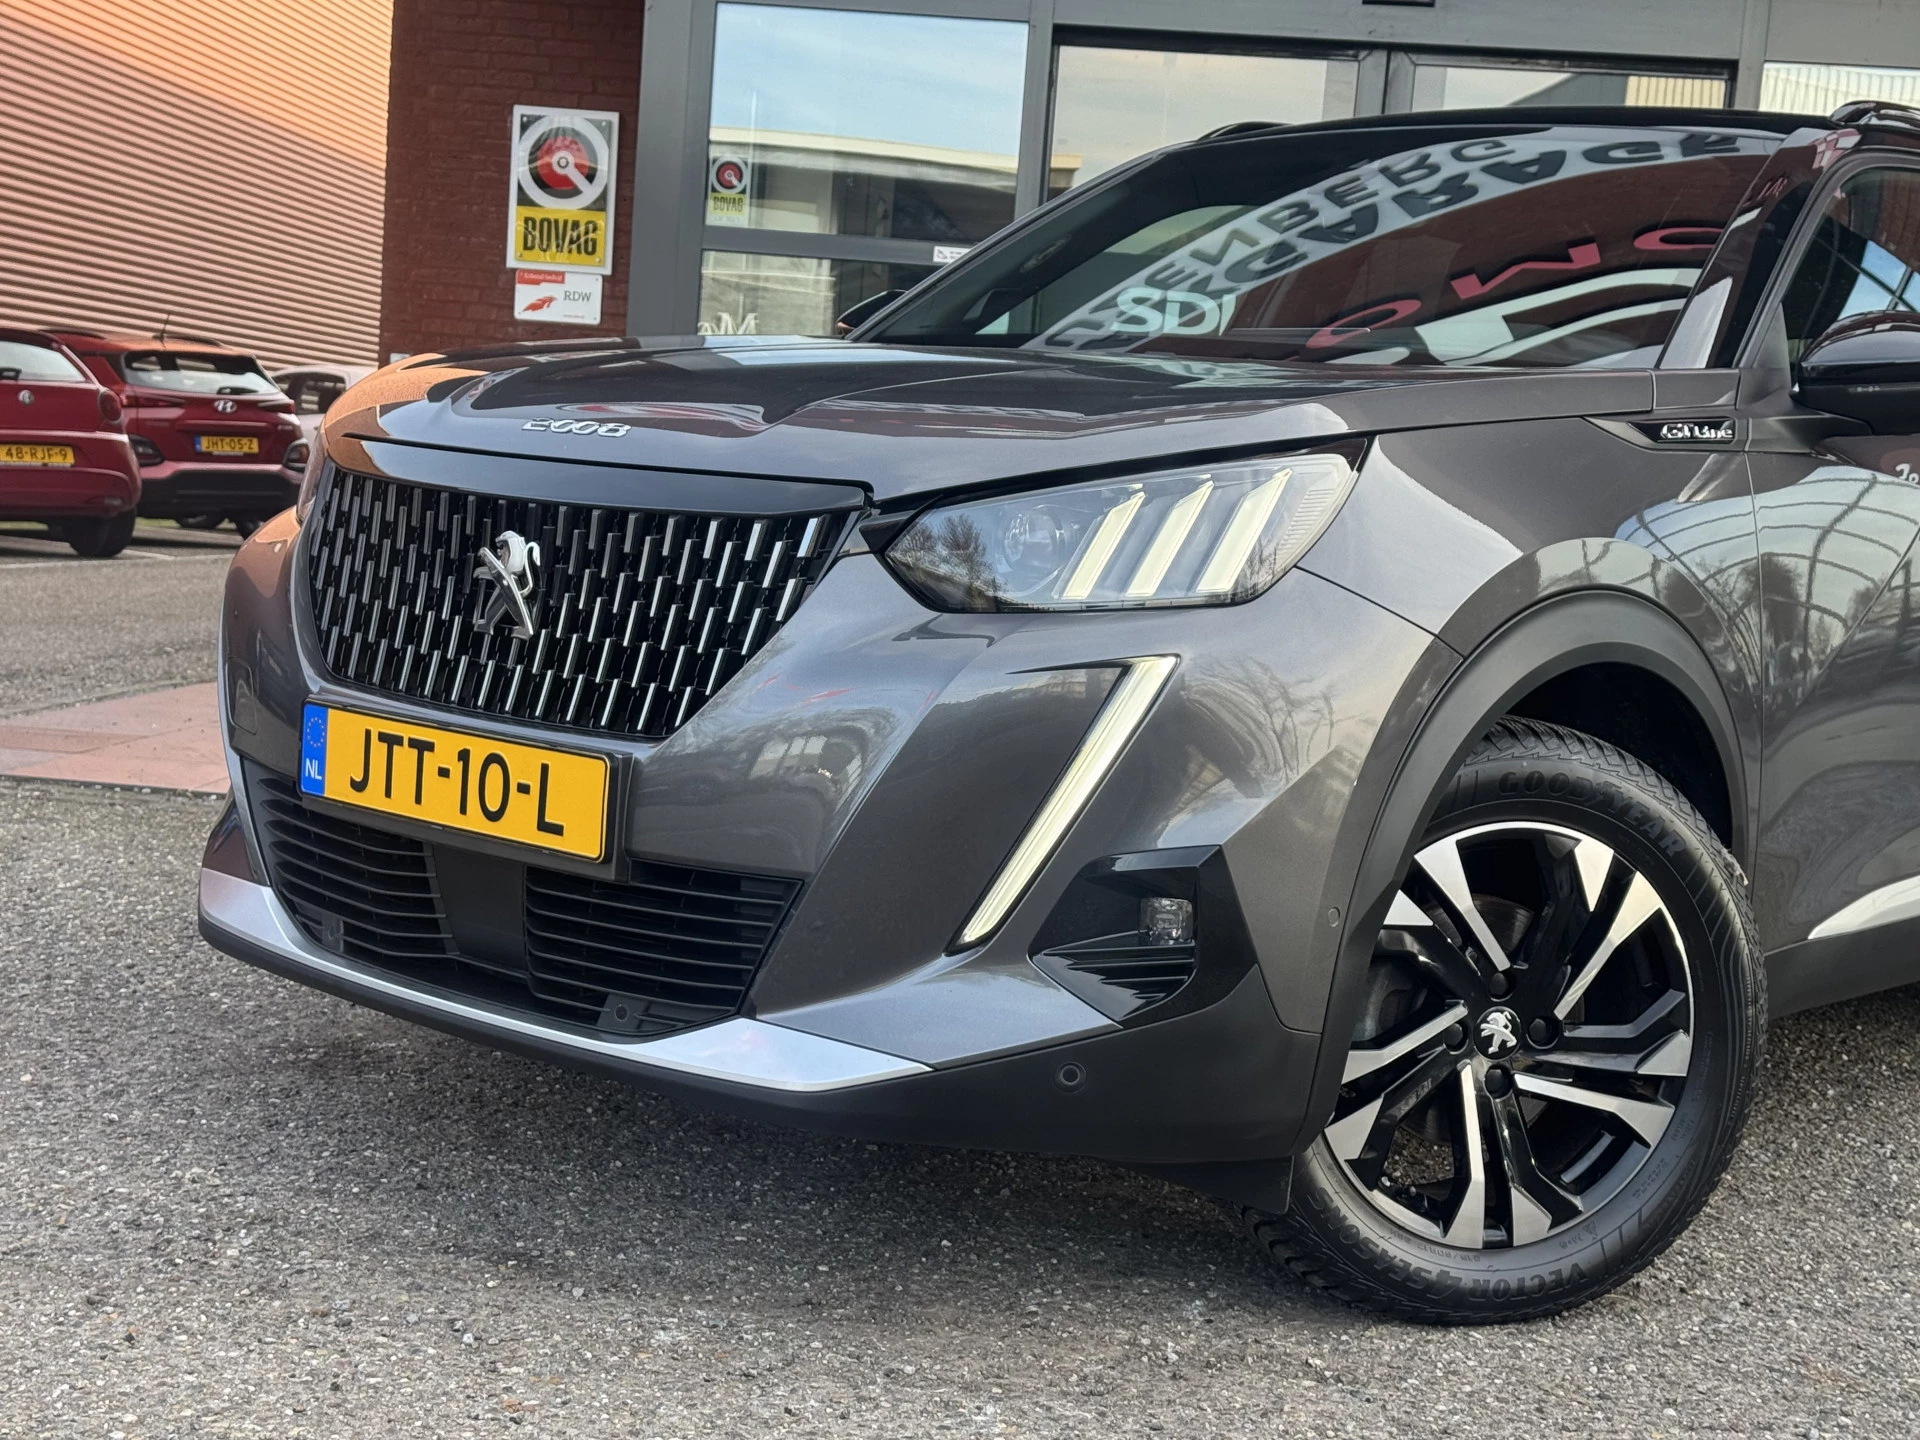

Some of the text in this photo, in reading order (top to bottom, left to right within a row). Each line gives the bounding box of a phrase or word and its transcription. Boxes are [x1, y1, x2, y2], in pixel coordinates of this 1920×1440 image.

[713, 196, 744, 213] BOVAG
[523, 216, 598, 256] BOVAG
[563, 289, 592, 303] RDW
[521, 417, 633, 438] 2008
[5, 446, 68, 461] 48-RJF-9
[304, 757, 323, 782] NL
[349, 727, 566, 837] JTT-10-L
[1498, 769, 1687, 858] GOODYEAR
[1468, 1261, 1588, 1301] VECTOR
